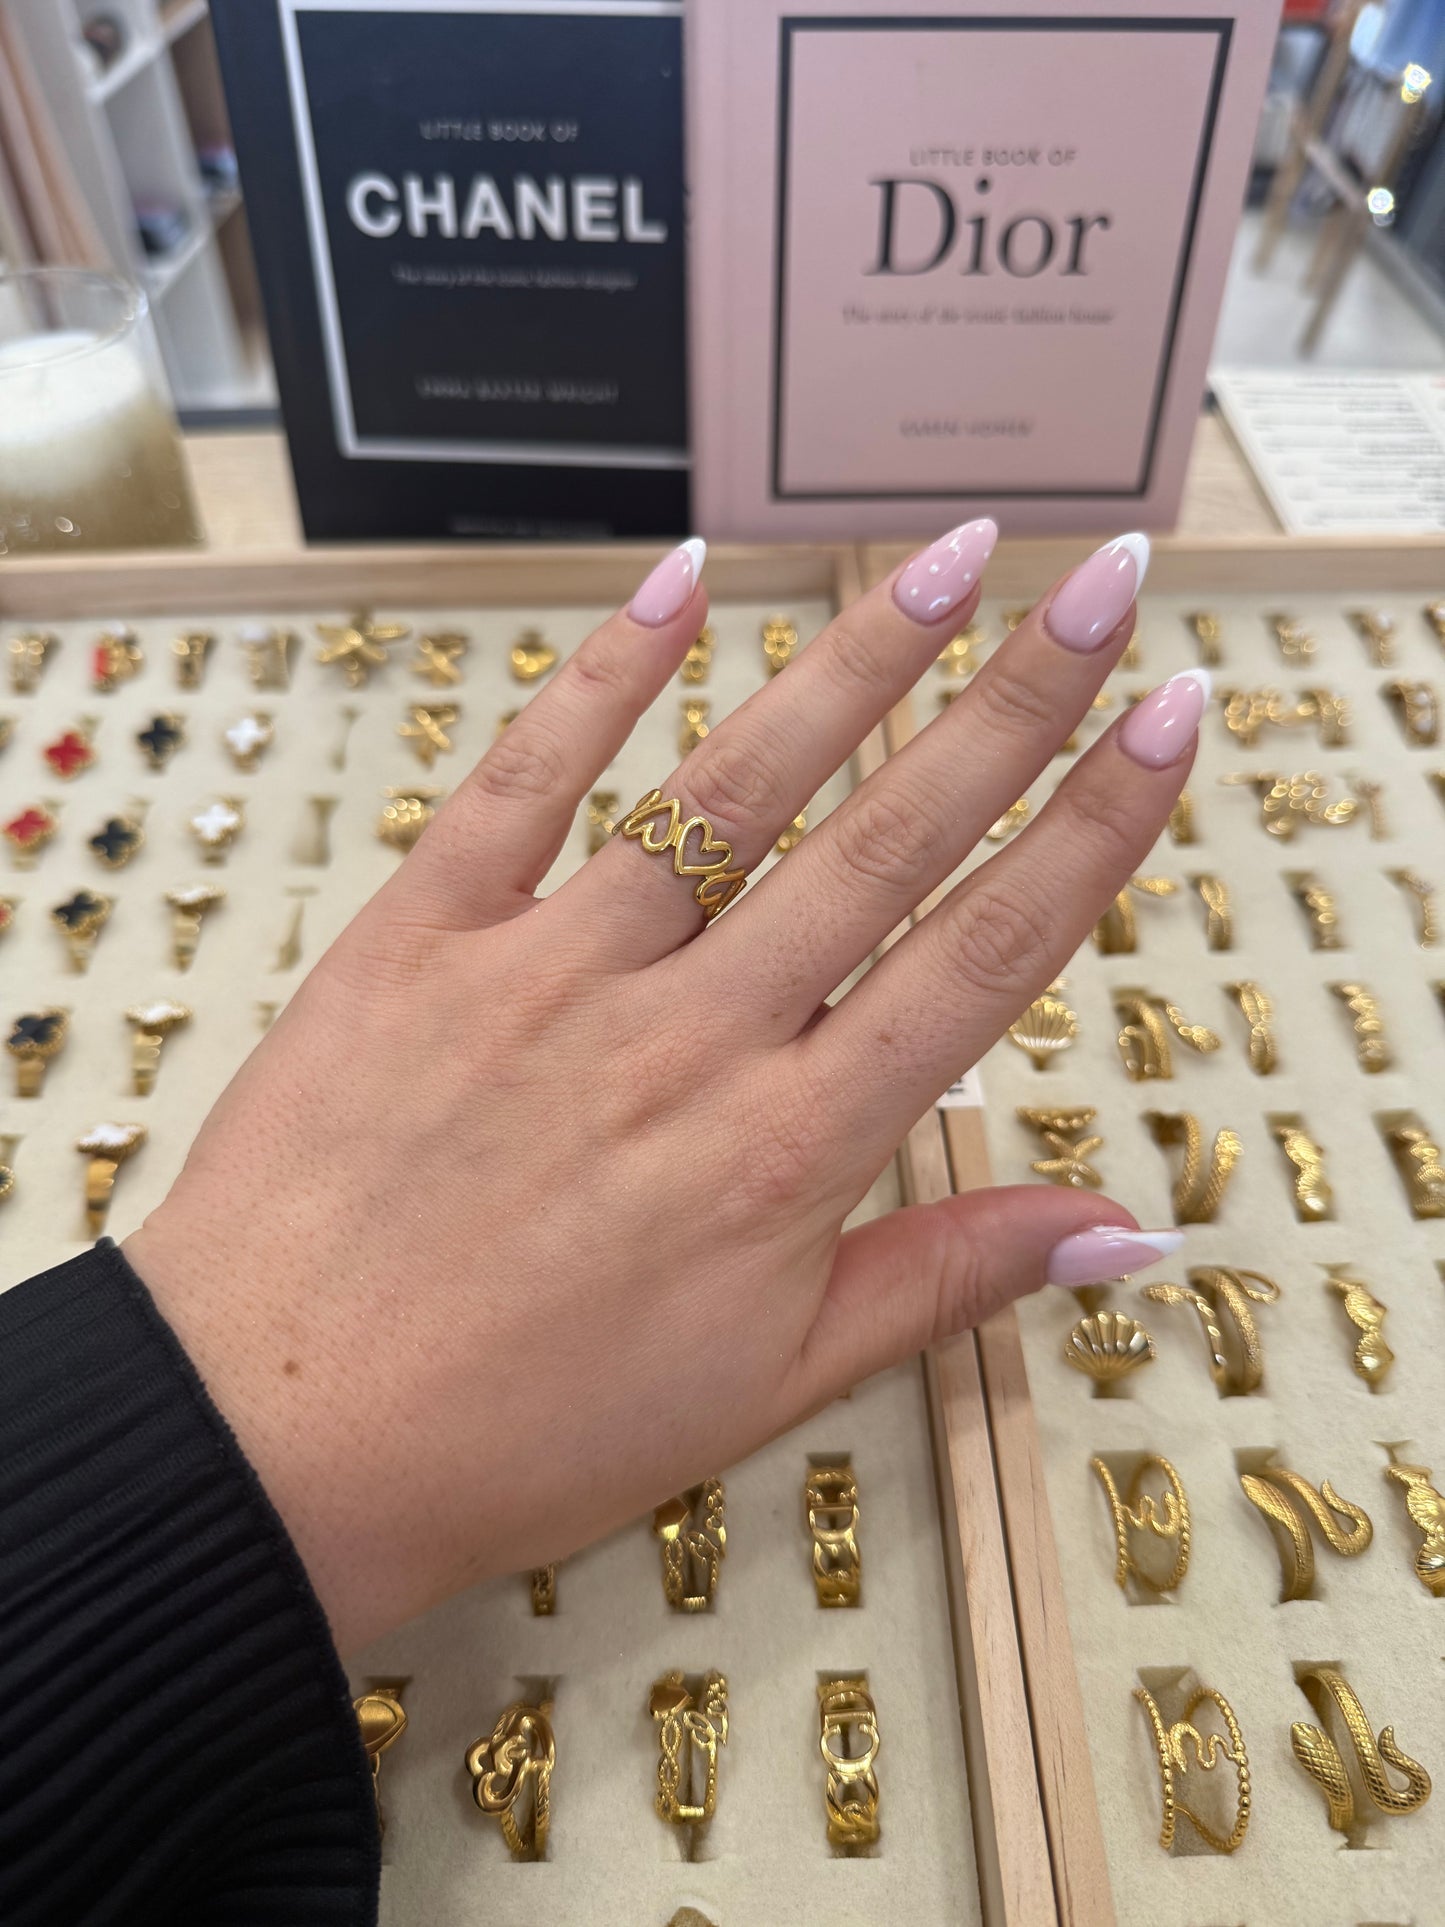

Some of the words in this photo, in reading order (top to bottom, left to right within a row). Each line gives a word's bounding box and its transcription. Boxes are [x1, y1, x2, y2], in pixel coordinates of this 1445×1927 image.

[420, 121, 482, 140] LITTLE
[488, 121, 546, 141] BOOK
[550, 122, 578, 142] OF
[909, 147, 974, 166] LITTLE
[982, 147, 1041, 166] BOOK
[1047, 147, 1077, 166] OF
[347, 171, 668, 243] CHANEL
[862, 173, 1112, 278] Dior
